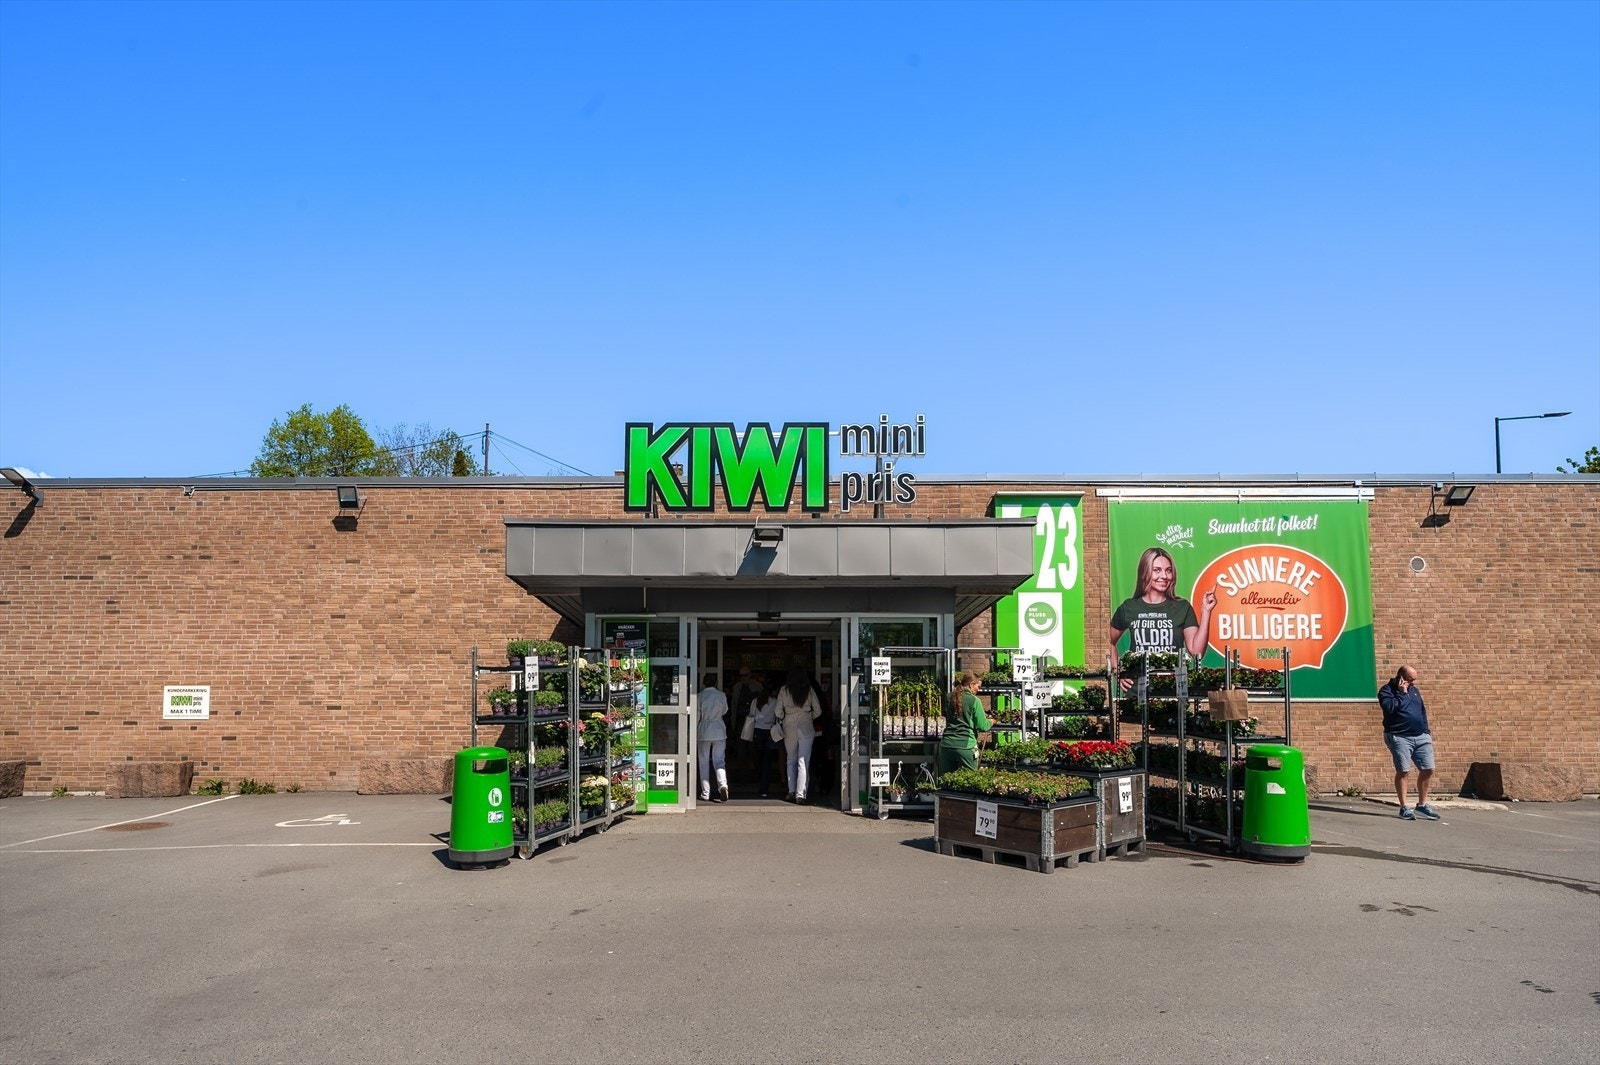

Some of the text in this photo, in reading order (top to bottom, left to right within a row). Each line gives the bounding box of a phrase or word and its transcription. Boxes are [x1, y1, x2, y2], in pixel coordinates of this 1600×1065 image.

[624, 414, 926, 512] KIWI mini
[840, 462, 917, 512] pris
[1156, 524, 1182, 544] Se etter
[1208, 514, 1318, 536] Sunnhet til folket!
[1167, 527, 1193, 545] merket!
[1001, 503, 1078, 590] 23
[1216, 556, 1322, 596] SUNNERE
[1240, 592, 1301, 605] alternativ
[1141, 619, 1155, 629] GIR
[1157, 619, 1173, 629] OSS
[1218, 613, 1323, 640] BILLIGERE
[1134, 628, 1174, 646] ALDRI
[1256, 648, 1280, 659] KIWI
[171, 695, 192, 705] KIWI
